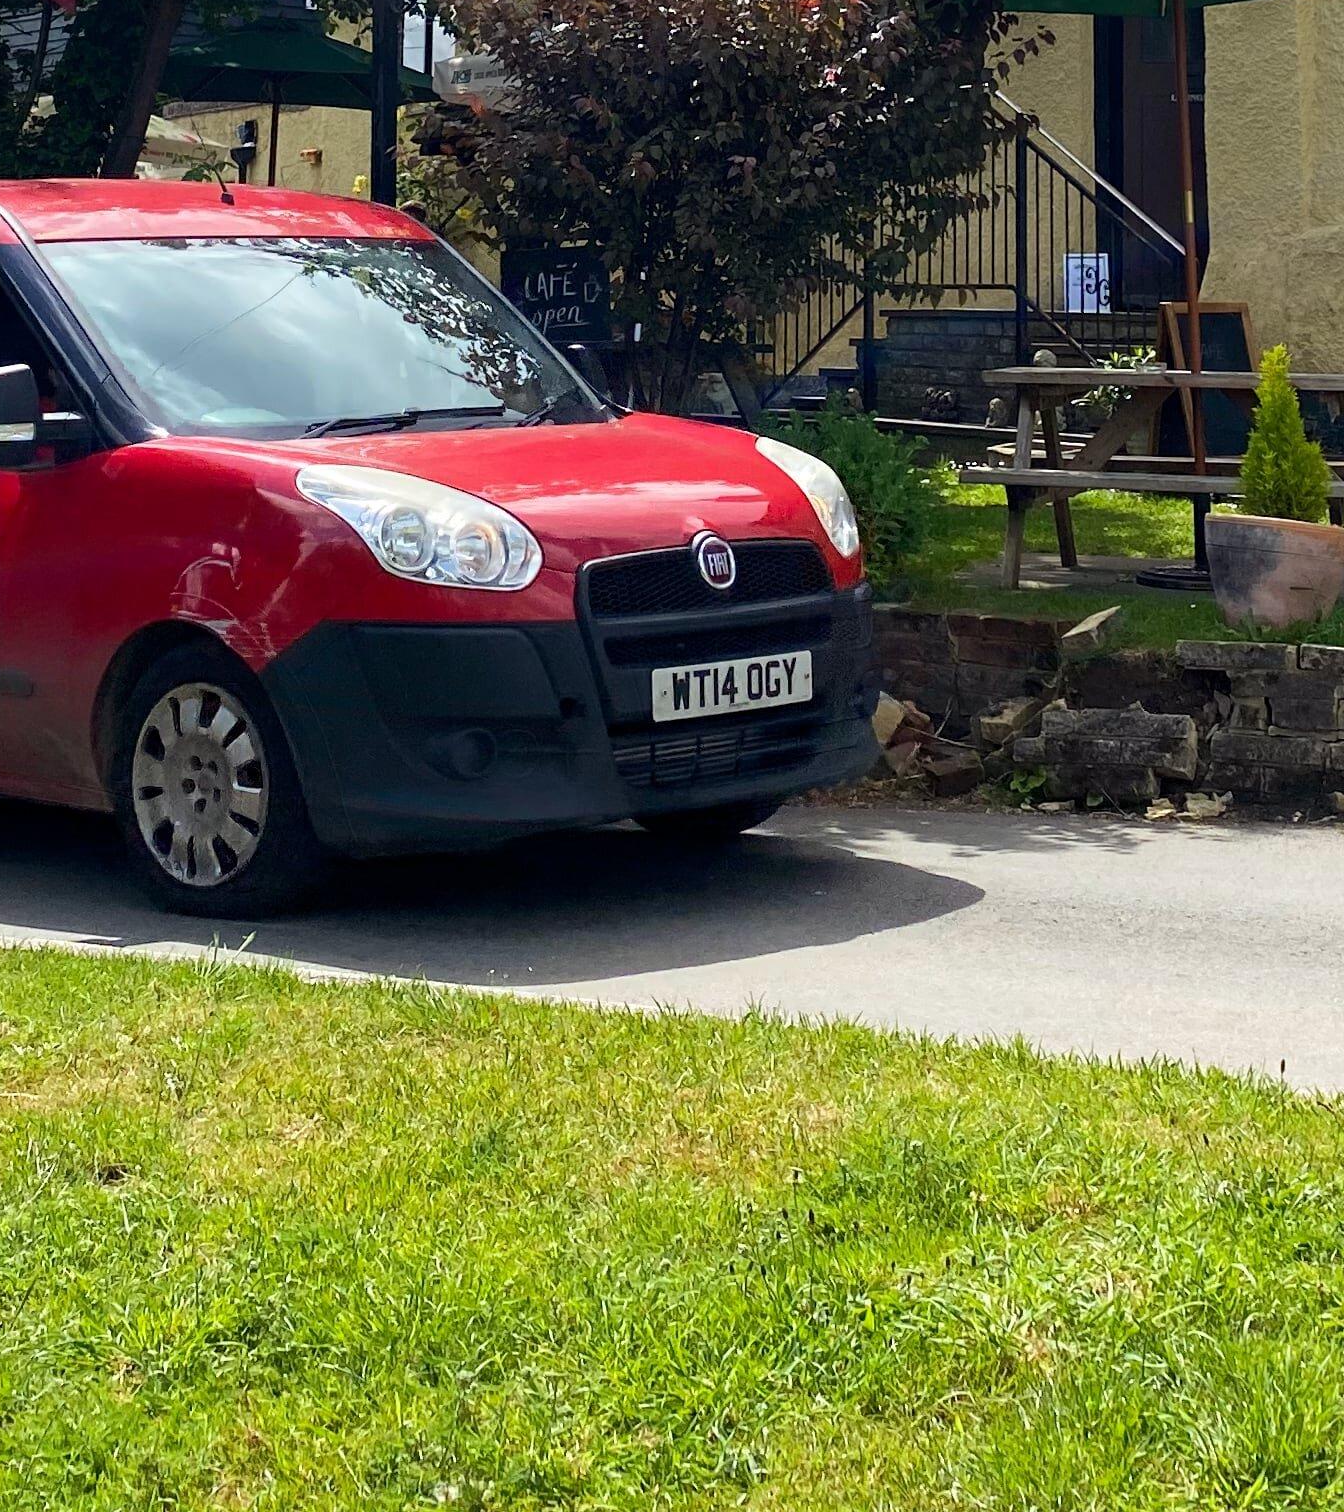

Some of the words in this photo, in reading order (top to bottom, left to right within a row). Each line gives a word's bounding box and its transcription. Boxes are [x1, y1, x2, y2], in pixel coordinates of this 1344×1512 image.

[707, 551, 730, 577] FIAT
[672, 666, 739, 711] WT14
[746, 657, 797, 701] OGY
